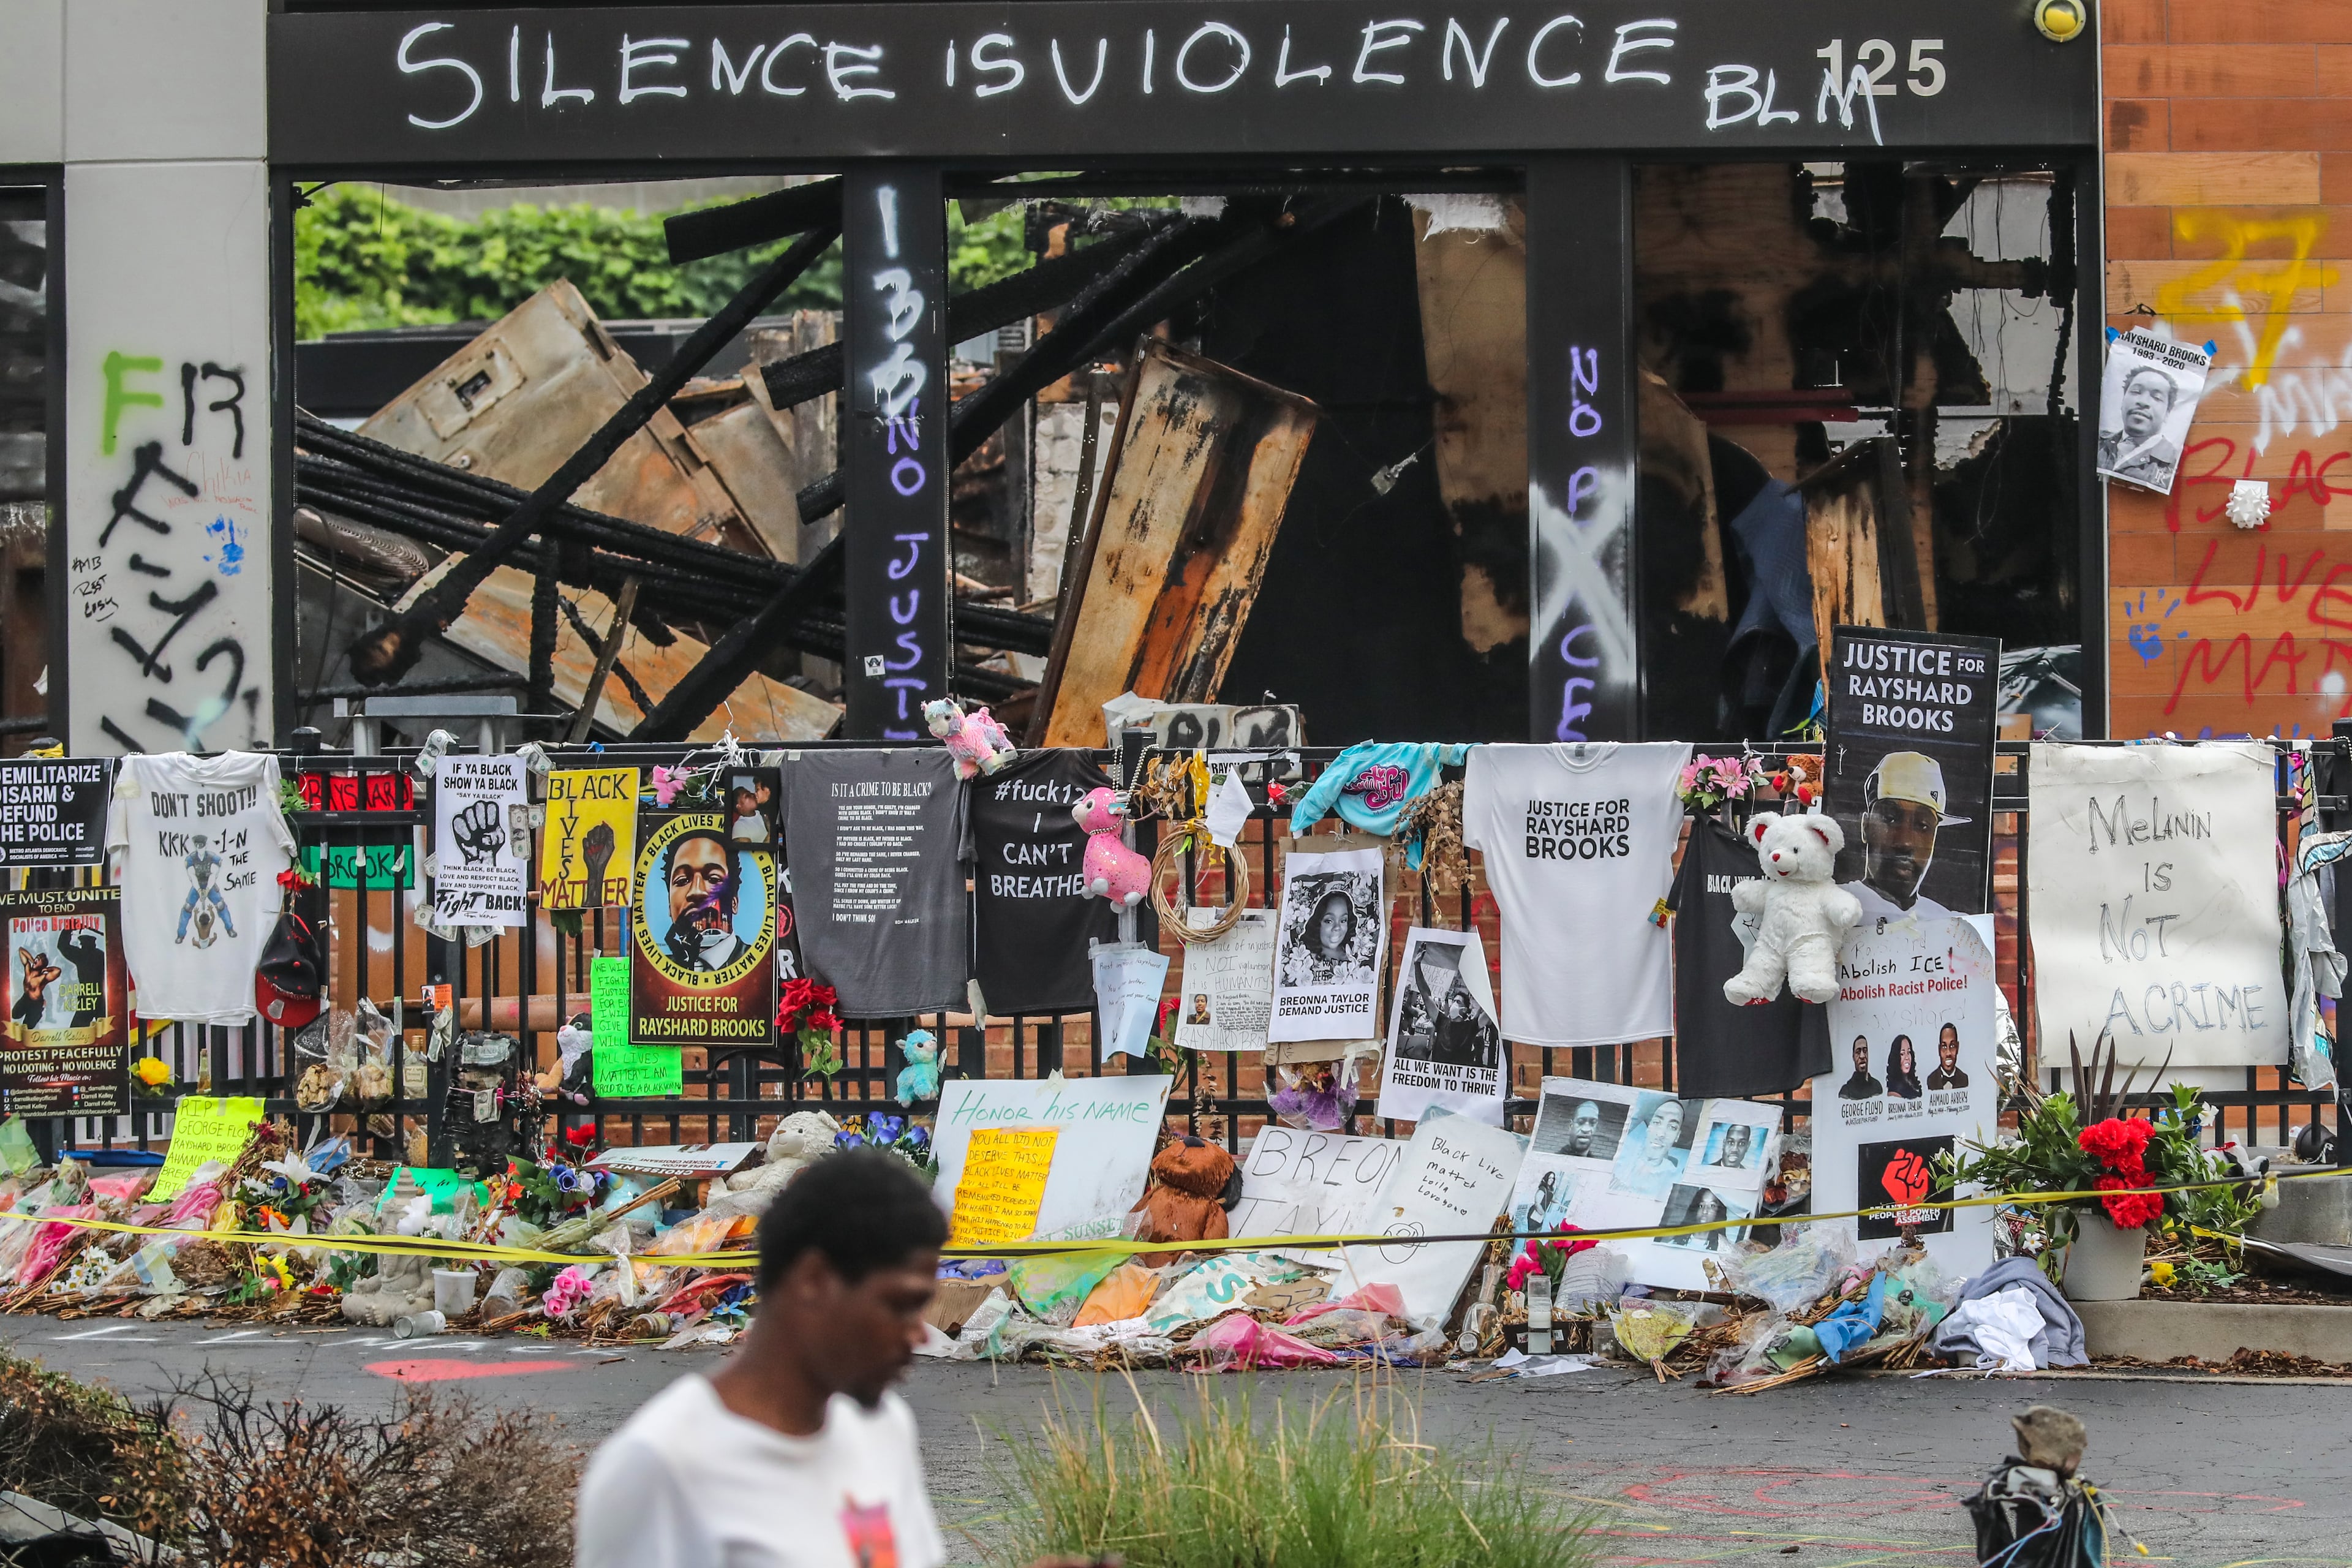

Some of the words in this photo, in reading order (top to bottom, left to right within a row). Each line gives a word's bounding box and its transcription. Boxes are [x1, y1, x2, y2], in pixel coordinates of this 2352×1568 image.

[397, 22, 895, 129] SILENCE
[946, 34, 1025, 99] IS
[1050, 15, 1677, 104] VIOLENCE
[1816, 39, 1947, 96] 125
[1705, 64, 1884, 146] BLM
[2117, 331, 2168, 354] RAYSHARD
[2168, 345, 2207, 367] BROOKS
[883, 530, 930, 741] JUST
[1843, 643, 1952, 676] JUSTICE
[1956, 657, 1986, 674] FOR
[1849, 674, 1973, 705] RAYSHARD
[1862, 703, 1954, 733] BROOKS
[0, 764, 101, 785] EMILITARIZE
[452, 764, 461, 774] IF
[466, 764, 478, 775] YA
[480, 764, 512, 776] BLACK
[61, 784, 75, 803] &
[444, 777, 472, 789] SHOW
[475, 778, 486, 790] YA
[488, 778, 518, 791] BLACK
[548, 774, 630, 801] BLACK
[831, 783, 839, 797] IS
[840, 783, 848, 797] IT
[849, 785, 854, 797] A
[856, 782, 880, 797] CRIME
[881, 782, 891, 796] TO
[892, 782, 902, 796] BE
[903, 782, 932, 797] BLACK?
[150, 791, 189, 818] DON'T
[197, 785, 257, 818] SHOOT!!
[1527, 799, 1589, 817] JUSTICE
[1594, 798, 1630, 816] FOR
[1, 824, 24, 842] HE
[29, 823, 85, 842] POLICE
[1033, 812, 1042, 834] I
[1526, 815, 1630, 837] RAYSHARD
[646, 824, 678, 858] BLACK
[681, 814, 721, 830] LIVES
[1002, 843, 1073, 866] CAN'T
[1525, 834, 1630, 861] BROOKS
[229, 851, 250, 866] THE
[224, 871, 257, 891] SAME
[990, 873, 1084, 899] BREATHE
[1706, 874, 1732, 894] BLACK
[2144, 861, 2173, 892] IS
[539, 877, 629, 910] MATTER
[633, 870, 647, 925] MATTER
[39, 903, 53, 914] TO
[54, 903, 75, 913] END
[13, 918, 48, 933] Police
[51, 915, 100, 931] Brutality
[753, 915, 775, 954] LIVES
[639, 928, 663, 964] LIVES
[59, 982, 102, 997] DARRELL
[1840, 984, 1885, 1002] Abolish
[1888, 981, 1924, 998] Racist
[1928, 974, 1968, 992] Police!
[64, 997, 98, 1011] KELLEY
[600, 998, 614, 1009] FOR
[666, 996, 712, 1013] JUSTICE
[714, 996, 738, 1013] FOR
[1280, 993, 1328, 1007] BREONNA
[1330, 993, 1370, 1004] TAYLOR
[2103, 986, 2144, 1038] A
[2144, 981, 2268, 1034] CRIME
[1278, 1005, 1322, 1017] DEMAND
[1324, 1003, 1369, 1015] JUSTICE
[599, 1019, 622, 1032] GIVE
[638, 1017, 708, 1037] RAYSHARD
[710, 1019, 766, 1038] BROOKS
[599, 1035, 624, 1047] WILL
[51, 1046, 123, 1059] PEACEFULLY
[601, 1052, 618, 1064] ALL
[624, 1052, 659, 1065] LIVES
[3, 1064, 16, 1074] NO
[17, 1062, 55, 1073] LOOTING
[62, 1061, 76, 1071] NO
[76, 1059, 116, 1071] VIOLENCE
[1393, 1058, 1411, 1072] ALL
[1414, 1061, 1430, 1074] WE
[1432, 1063, 1463, 1079] WANT
[1466, 1067, 1476, 1080] IS
[1479, 1068, 1498, 1082] THE
[28, 1074, 50, 1083] Follow
[60, 1072, 81, 1082] Music
[1392, 1072, 1441, 1090] FREEDOM
[1444, 1077, 1458, 1092] TO
[1461, 1080, 1497, 1096] THRIVE
[181, 1098, 213, 1118] RIP
[1888, 1103, 1906, 1114] BREONNA
[1907, 1100, 1923, 1112] TAYLOR
[1929, 1093, 1950, 1107] AHMAUD
[1950, 1090, 1969, 1104] ARBERY
[1841, 1103, 1864, 1118] GEORGE
[1864, 1101, 1883, 1115] FLOYD
[973, 1134, 990, 1146] YOU
[993, 1134, 1010, 1145] ALL
[1032, 1136, 1055, 1148] NOT
[969, 1150, 1008, 1162] DESERVE
[1014, 1152, 1047, 1166] THIS!!
[1433, 1136, 1470, 1163] Black
[1478, 1157, 1506, 1180] Live
[607, 1163, 694, 1176] CROISSANTS
[964, 1166, 990, 1177] BLACK
[992, 1166, 1015, 1178] LIVES
[1017, 1170, 1048, 1183] MATTER
[1895, 1213, 1940, 1224] ASSEMBLY
[1909, 1207, 1941, 1216] POWER
[953, 1212, 970, 1224] THAT
[970, 1216, 985, 1224] THIS
[985, 1216, 1013, 1230] HAPPENED
[1021, 1222, 1032, 1231] ALL
